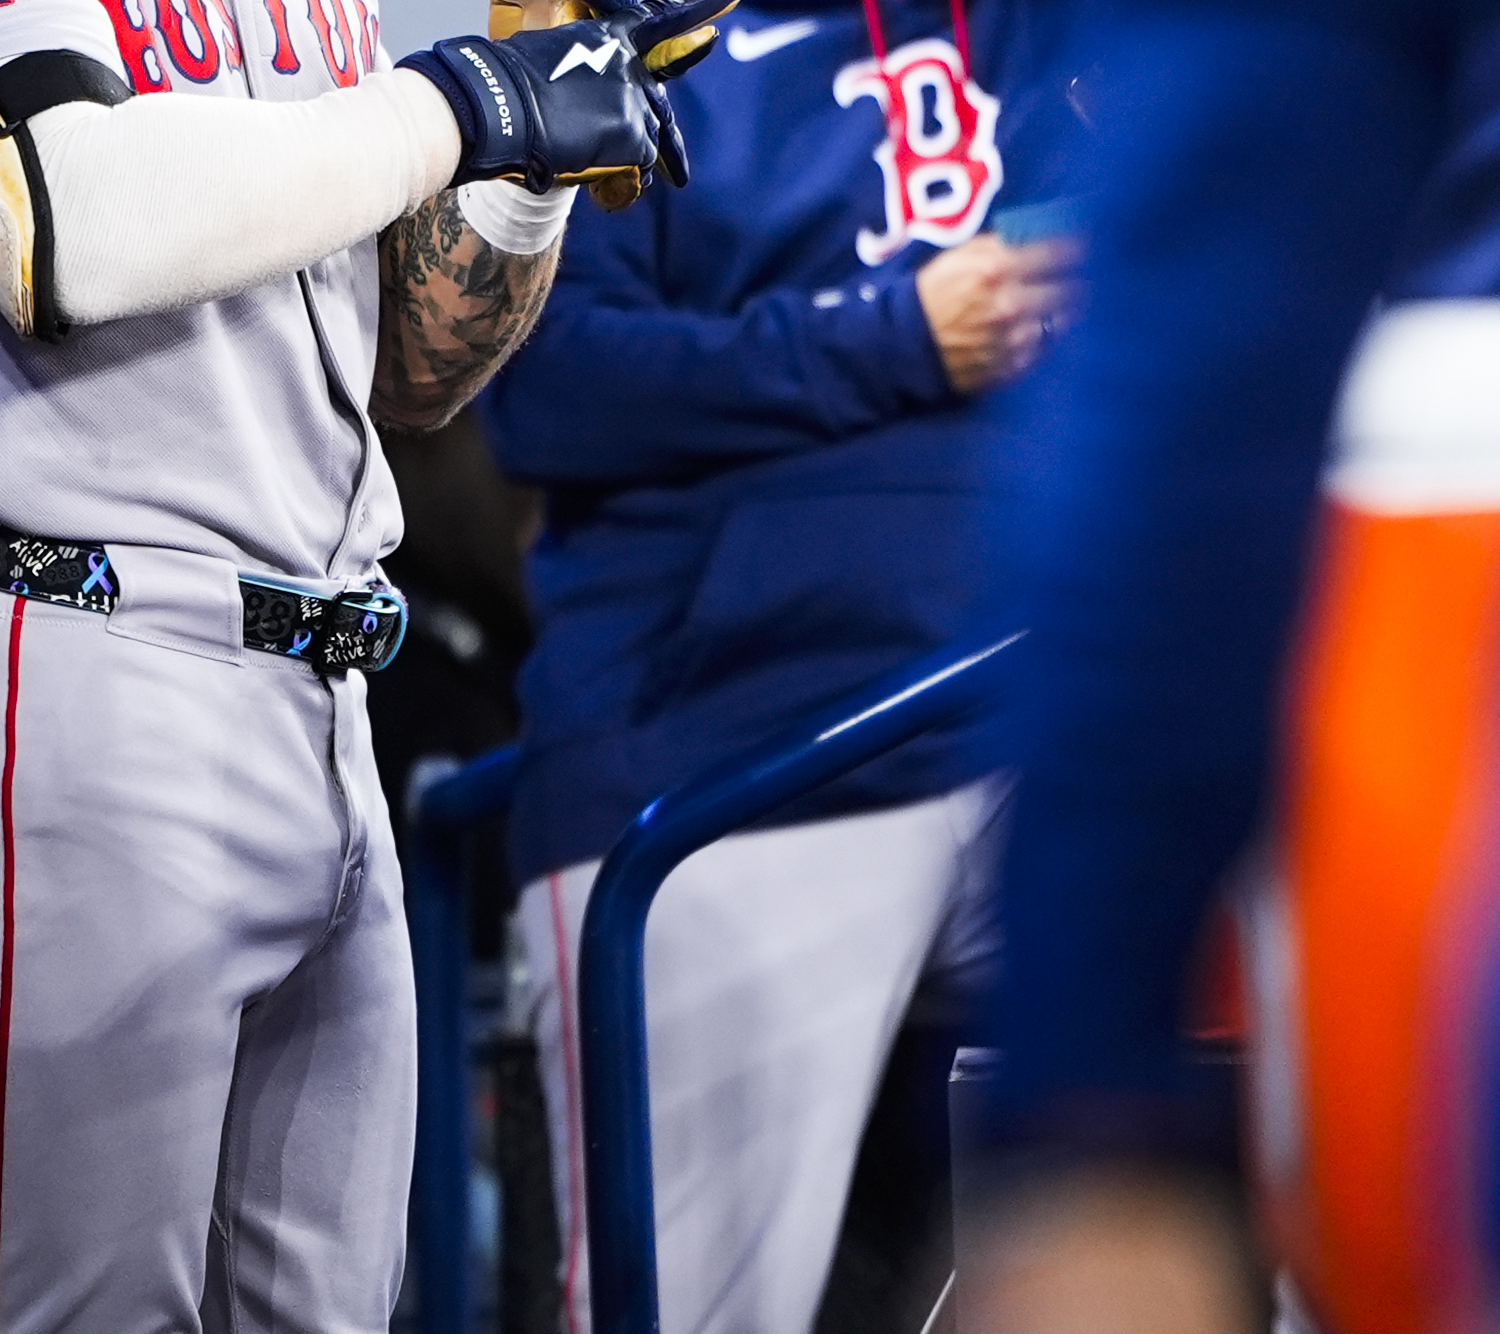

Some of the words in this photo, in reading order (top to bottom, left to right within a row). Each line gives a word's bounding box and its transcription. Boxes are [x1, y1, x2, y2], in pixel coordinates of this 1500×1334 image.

[833, 38, 1003, 267] B
[9, 540, 44, 577] Alive
[325, 645, 367, 664] Alive
